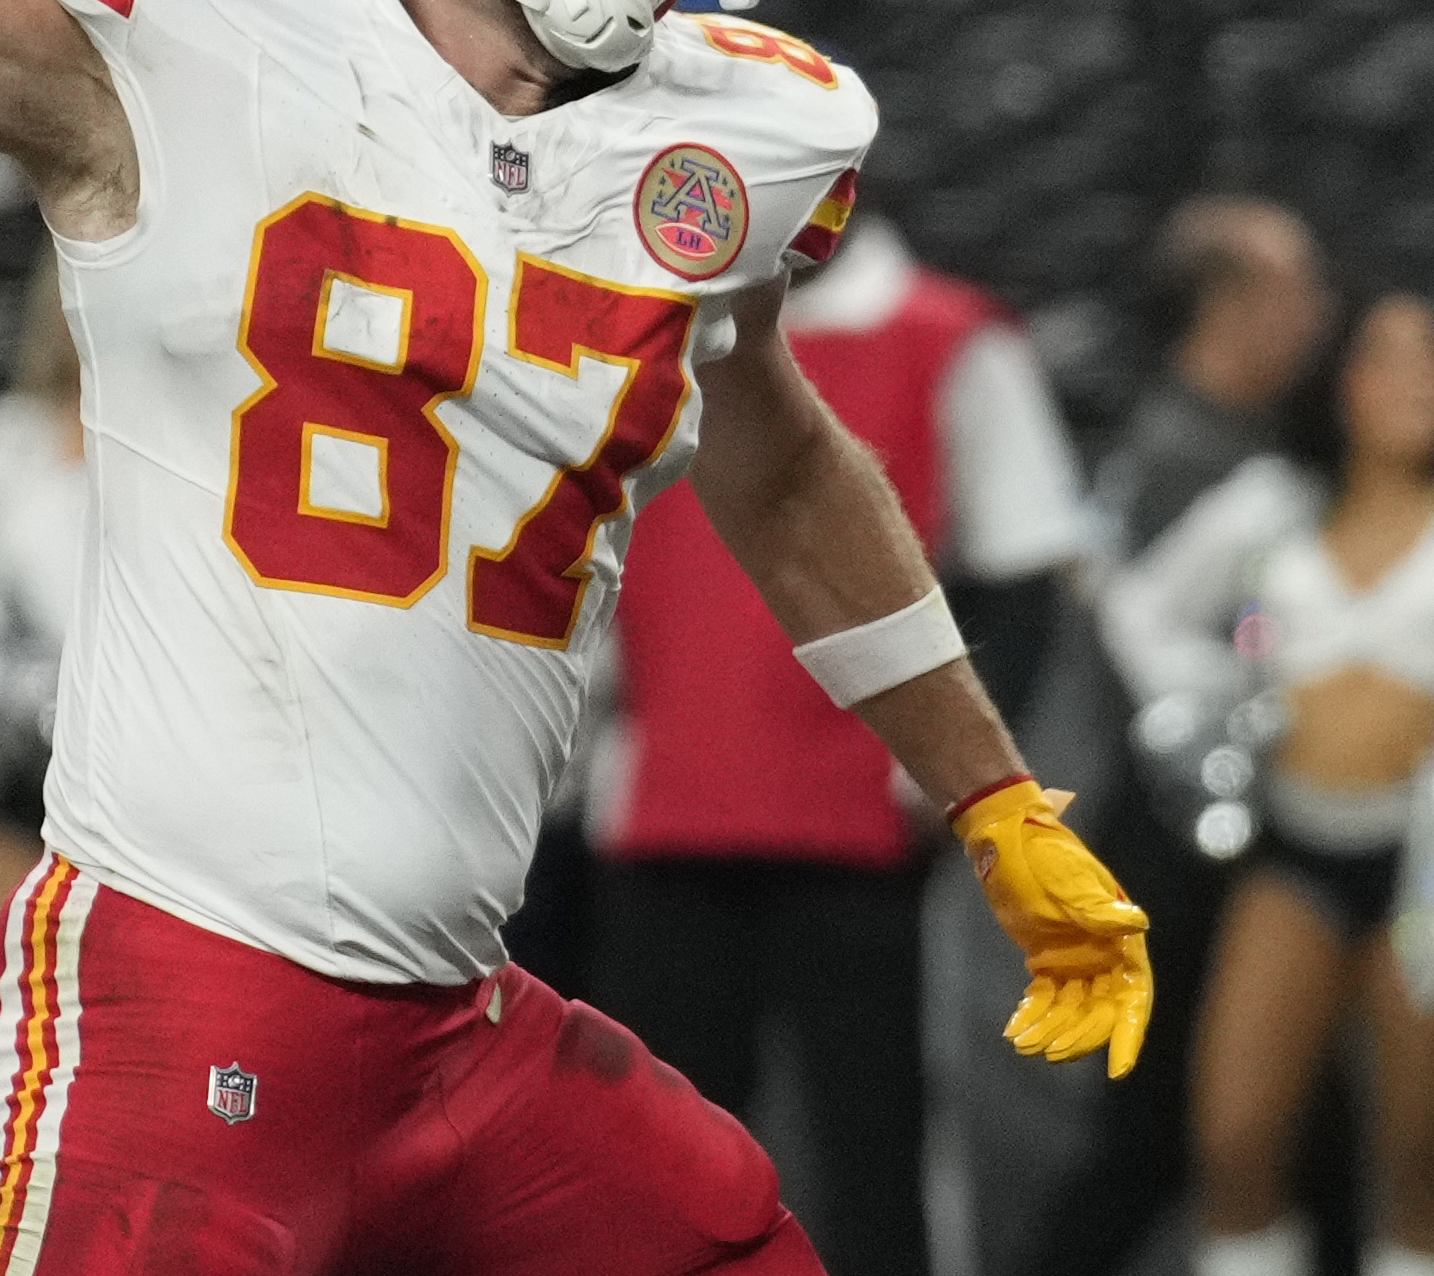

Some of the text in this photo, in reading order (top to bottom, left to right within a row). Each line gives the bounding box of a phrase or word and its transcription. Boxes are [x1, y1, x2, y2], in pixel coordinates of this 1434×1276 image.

[650, 157, 730, 241] A
[675, 227, 702, 251] LH
[223, 190, 699, 652] 87
[216, 1088, 248, 1115] NFL
